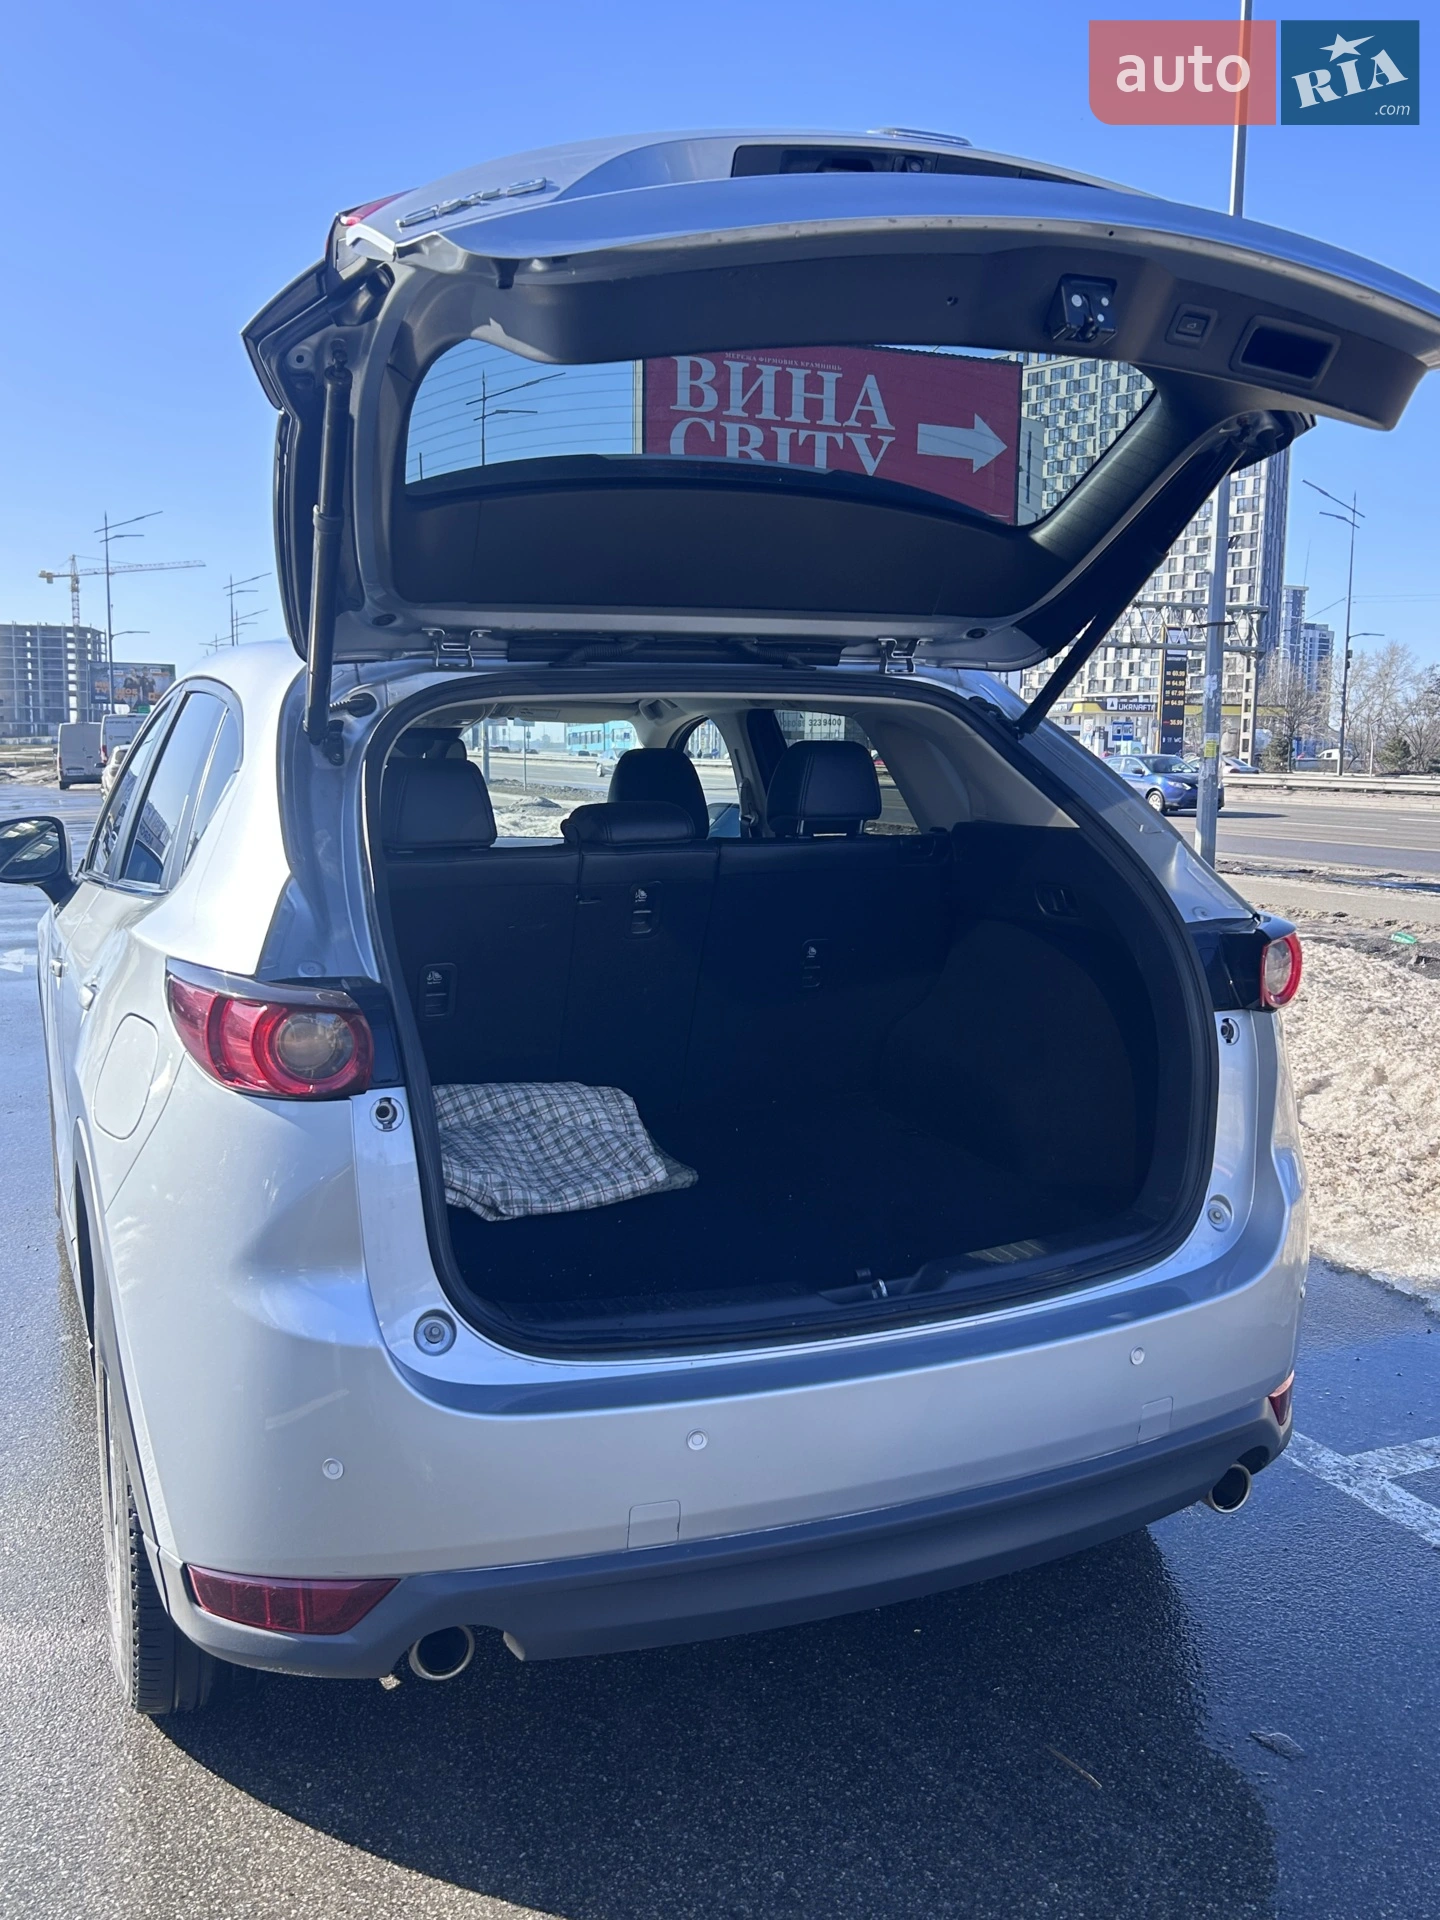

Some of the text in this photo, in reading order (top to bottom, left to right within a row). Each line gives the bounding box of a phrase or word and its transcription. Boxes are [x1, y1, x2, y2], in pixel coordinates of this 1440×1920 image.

[725, 352, 757, 362] МЕРЕЖА
[758, 357, 798, 366] ФІРМОВИХ
[670, 356, 895, 430] ВИНА
